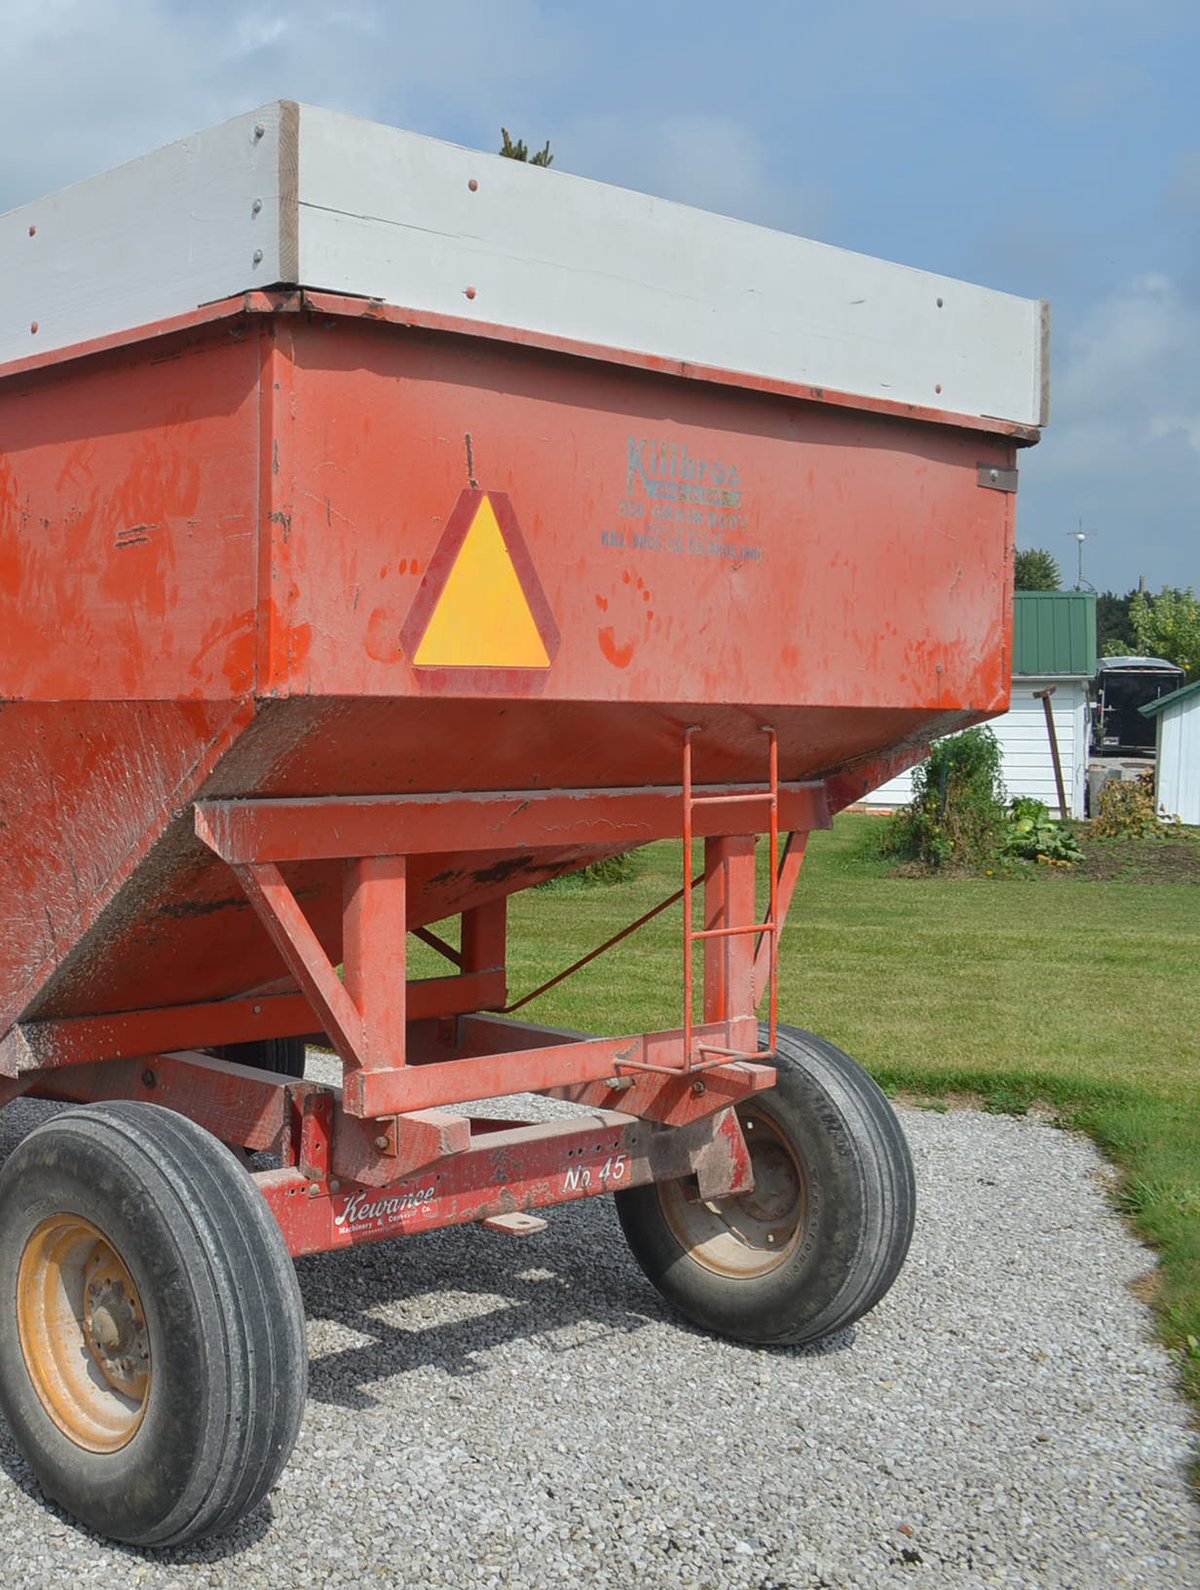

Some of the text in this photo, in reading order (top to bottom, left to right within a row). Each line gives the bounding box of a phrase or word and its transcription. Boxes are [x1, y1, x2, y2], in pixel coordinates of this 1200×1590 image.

[627, 436, 741, 496] Killbros
[598, 1154, 626, 1182] 45
[335, 1187, 435, 1225] Kewanee
[339, 1222, 373, 1235] Machinery
